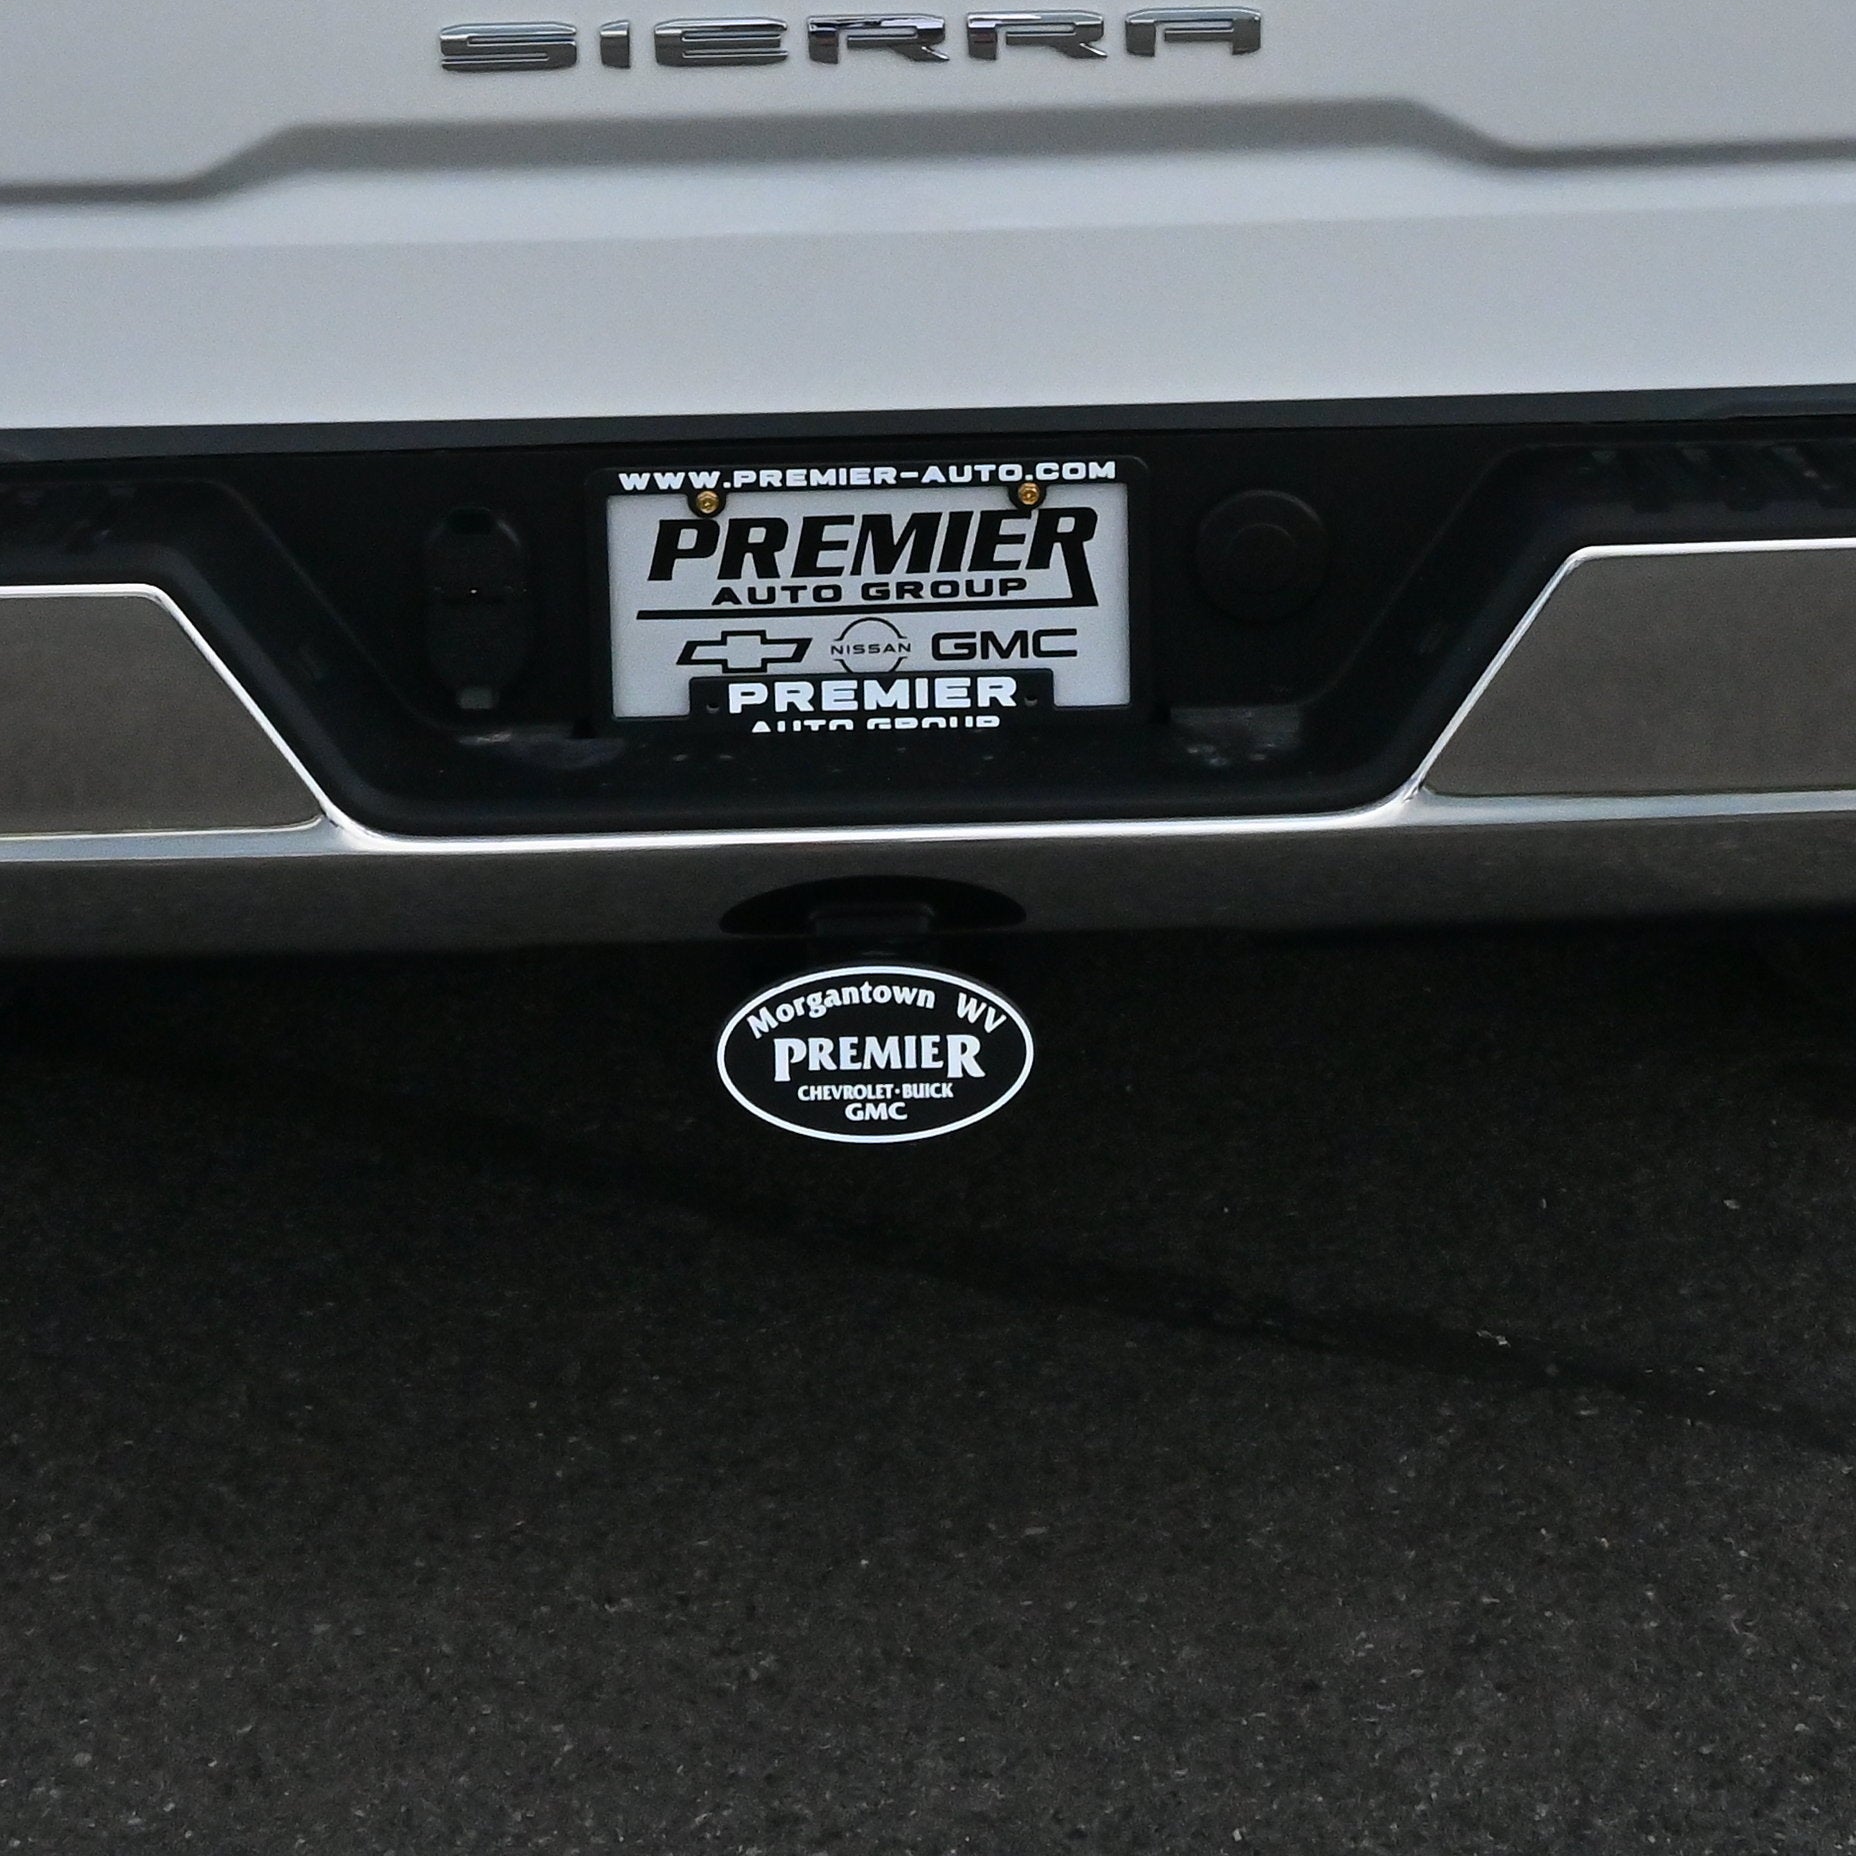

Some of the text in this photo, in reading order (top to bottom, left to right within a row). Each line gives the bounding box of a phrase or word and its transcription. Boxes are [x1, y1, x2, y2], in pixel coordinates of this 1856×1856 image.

[439, 6, 1262, 72] SIERRA
[618, 461, 1116, 492] WWW.PREMIER-AUTO.COM
[647, 506, 1099, 586] PREMIER
[711, 577, 1028, 606] AUTO GROUP
[830, 628, 1078, 662] NISSAN GMC
[728, 676, 1018, 715] PREMIER
[746, 981, 1007, 1040] Morgantown WV
[773, 1033, 986, 1083] PREMIER
[844, 1101, 908, 1122] GMC
